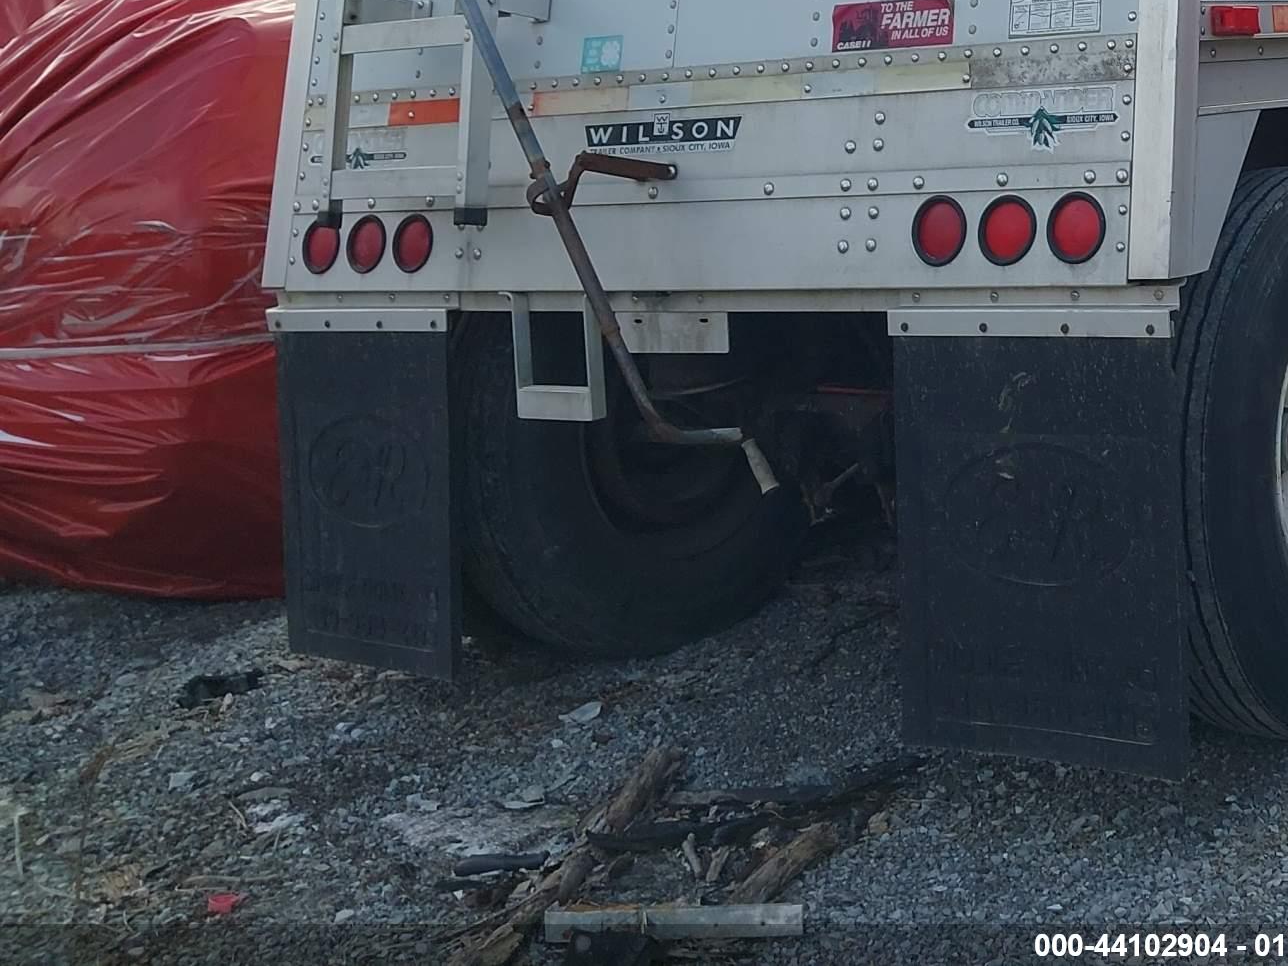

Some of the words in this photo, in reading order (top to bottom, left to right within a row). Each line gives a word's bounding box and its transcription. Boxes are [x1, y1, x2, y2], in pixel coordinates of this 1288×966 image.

[880, 3, 893, 13] TO
[895, 1, 914, 11] THE
[880, 8, 951, 30] FARMER
[891, 31, 901, 40] IN
[902, 28, 919, 39] ALL
[921, 28, 934, 37] OF
[935, 26, 949, 36] US
[1066, 115, 1084, 123] SIOUX
[1099, 113, 1115, 122] IOWA
[589, 119, 735, 144] WILSON
[663, 144, 686, 153] SIOUX
[708, 142, 730, 150] IOWA
